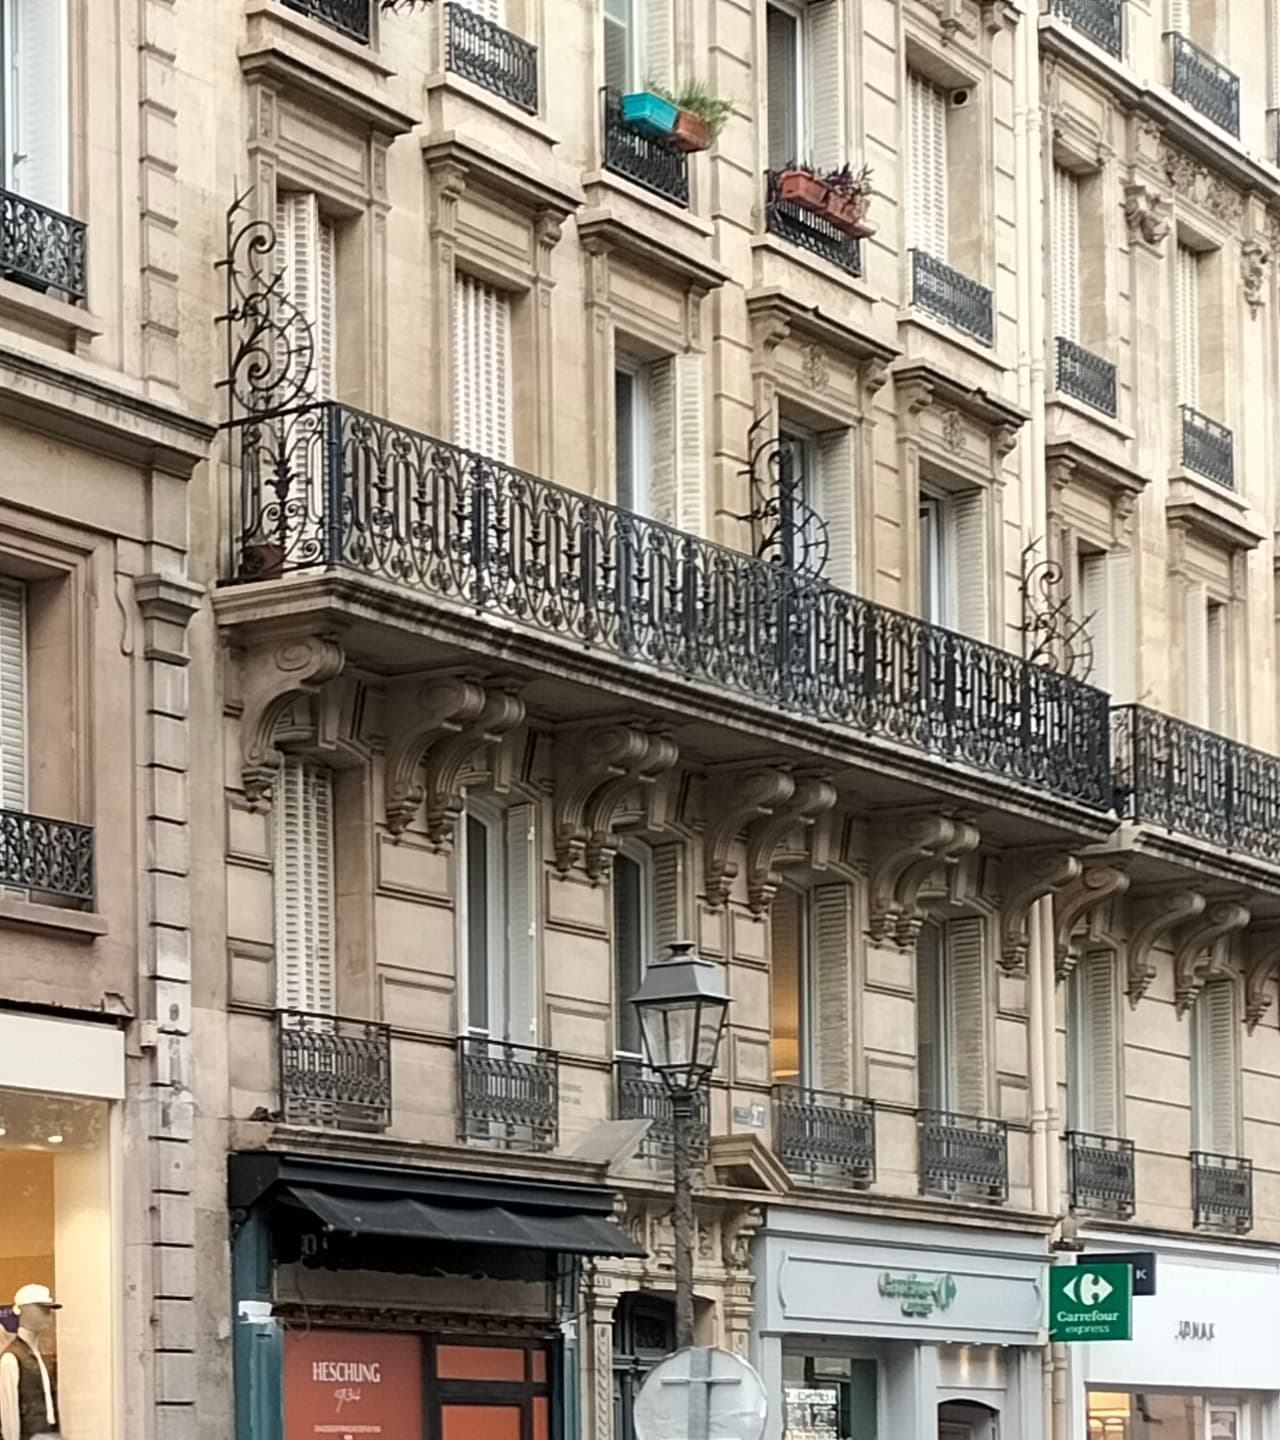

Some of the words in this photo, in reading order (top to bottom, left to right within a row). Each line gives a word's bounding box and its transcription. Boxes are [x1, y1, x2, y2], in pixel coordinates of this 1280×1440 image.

[1056, 1310, 1119, 1323] Carrefour
[1065, 1324, 1110, 1336] express
[312, 1361, 381, 1383] HESCHUNG
